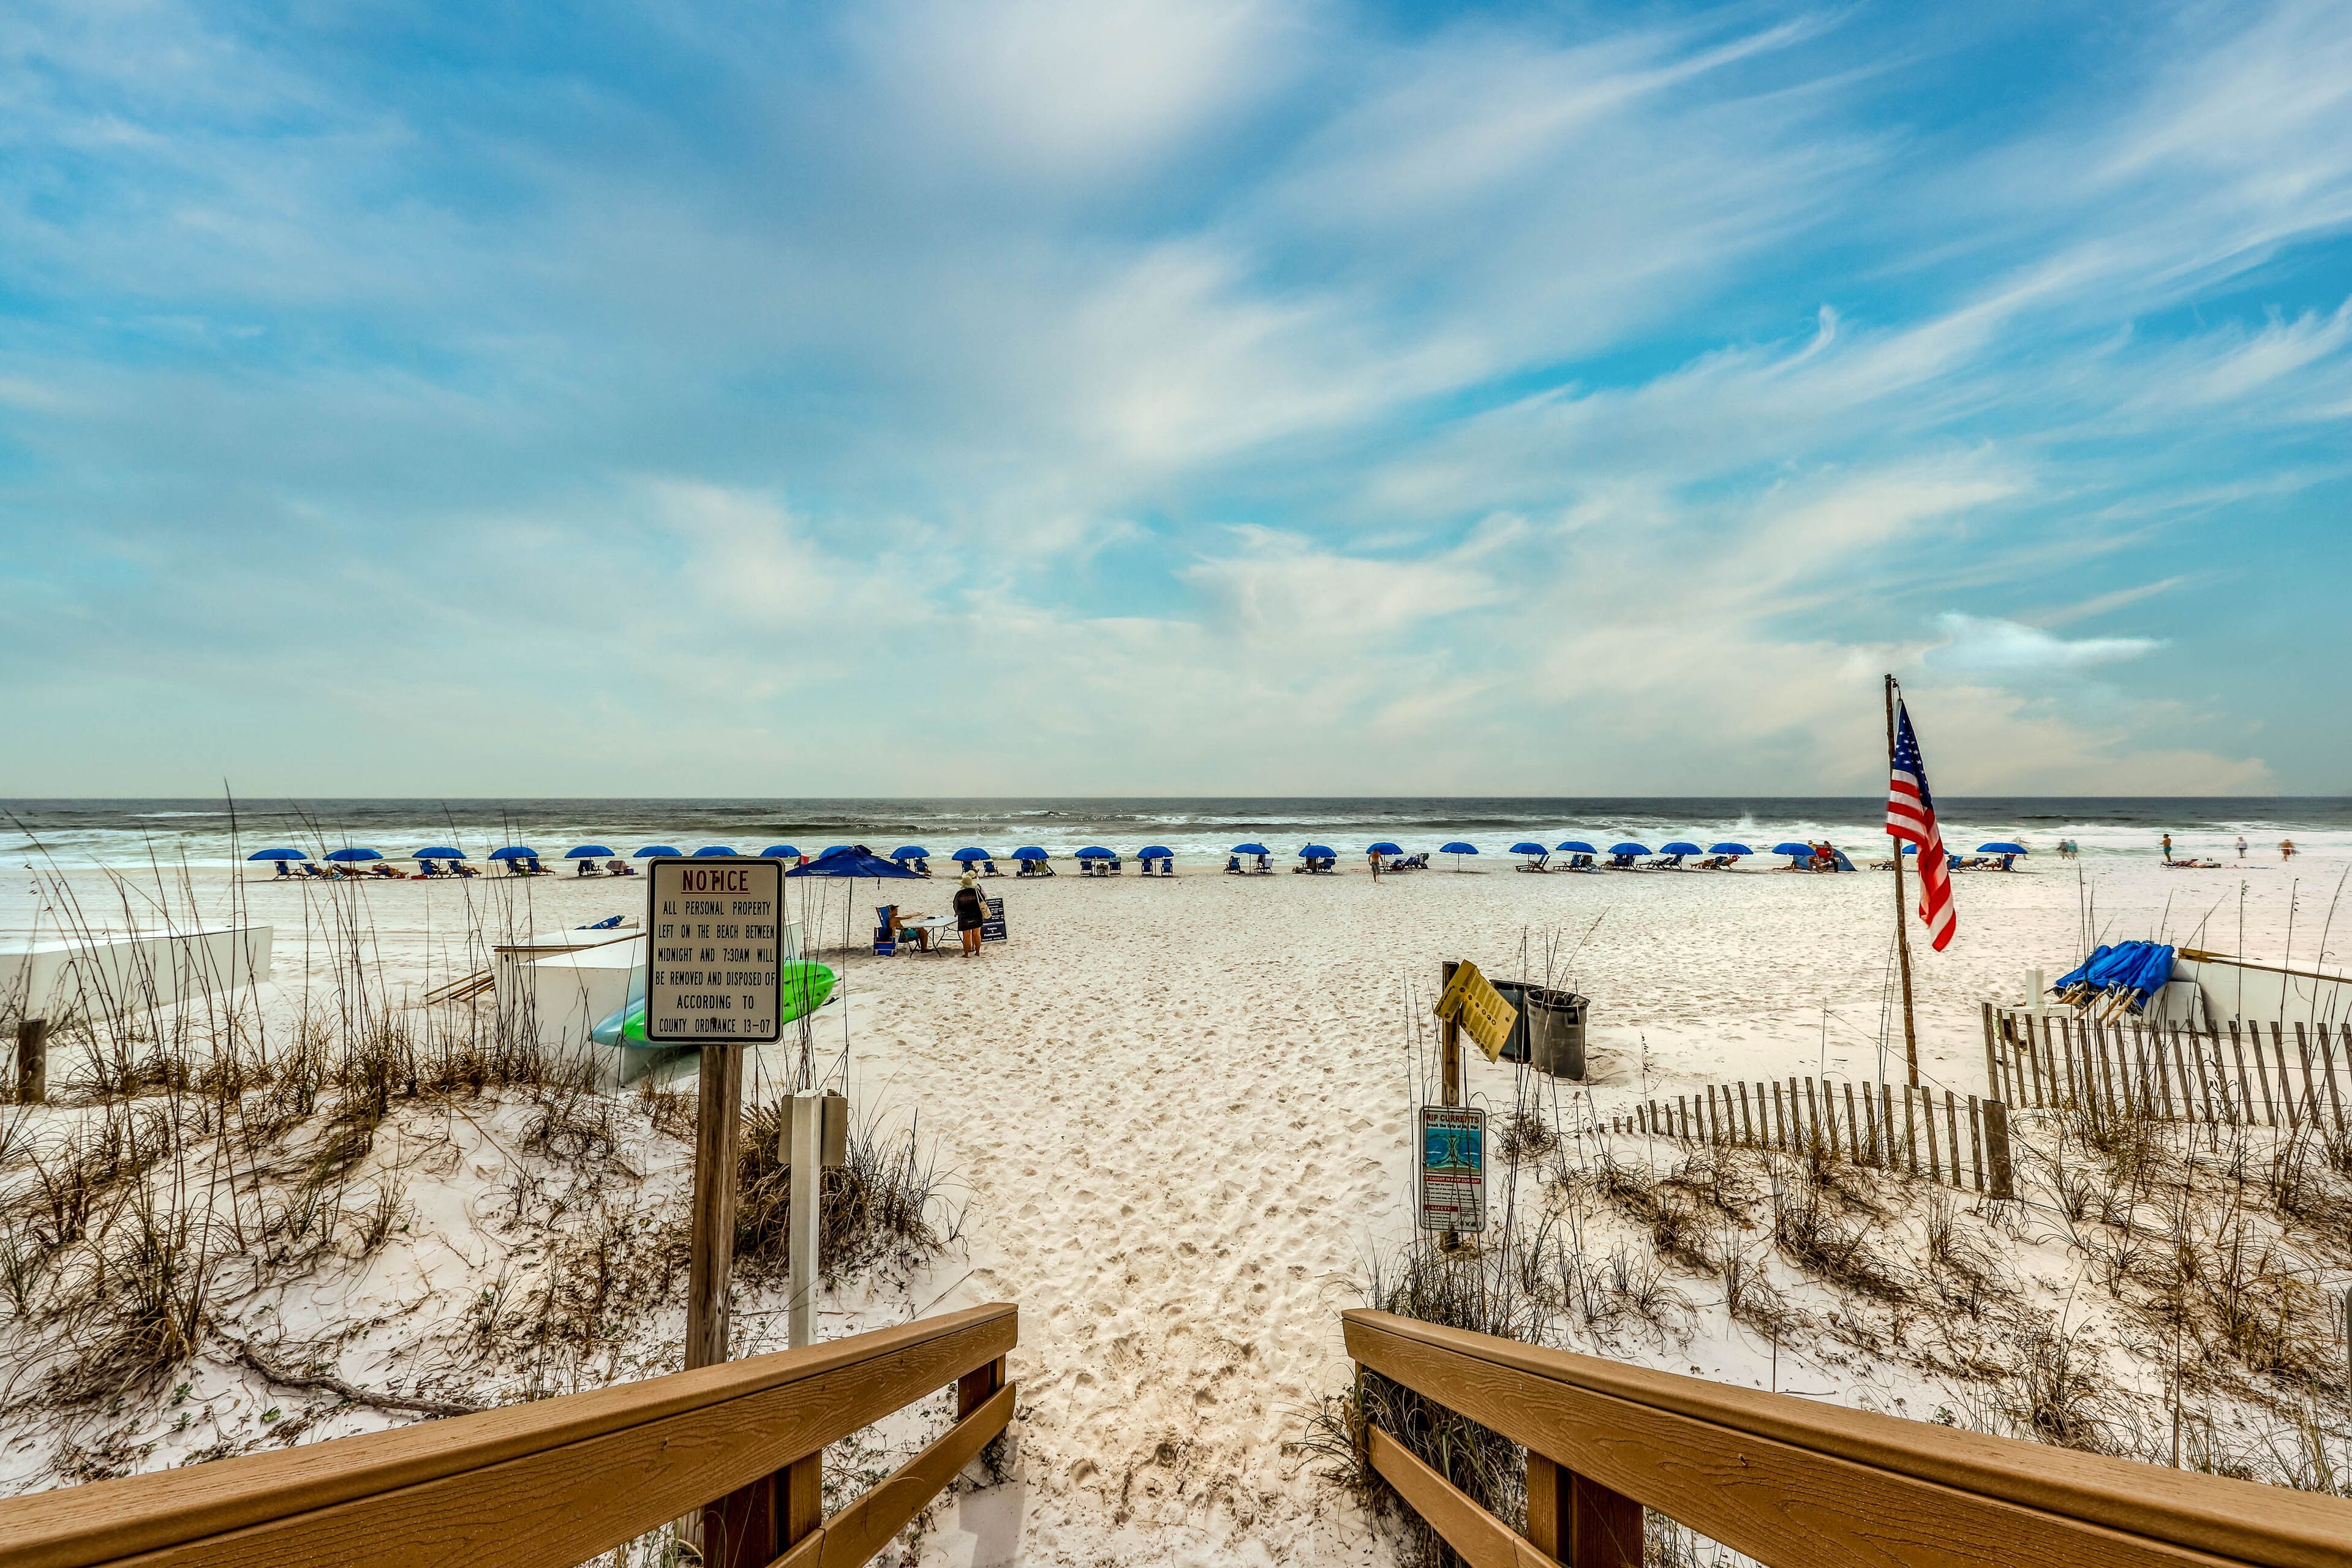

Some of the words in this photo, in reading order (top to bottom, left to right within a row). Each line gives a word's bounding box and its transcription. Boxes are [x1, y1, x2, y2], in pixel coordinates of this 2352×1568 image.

[682, 870, 748, 891] NOTICE
[663, 901, 677, 915] ALL
[685, 901, 724, 915] PERSONAL
[733, 901, 771, 915] PROPERTY
[658, 924, 674, 938] LEFT
[681, 924, 690, 938] ON
[697, 924, 709, 938] THE
[717, 924, 738, 938] BEACH
[745, 924, 774, 939] BETWEEN
[658, 948, 693, 962] MIDNIGHT
[699, 948, 715, 962] AND
[723, 948, 750, 962] 7:30AM
[757, 948, 774, 962] WILL
[655, 971, 665, 985] BE
[670, 971, 703, 986] REMOVED
[707, 971, 722, 986] AND
[726, 971, 761, 986] DISPOSED
[765, 972, 775, 986] OF
[676, 995, 731, 1009] ACCORDING
[742, 995, 754, 1009] TO
[659, 1019, 687, 1032] COUNTY
[695, 1019, 736, 1033] ORDINANCE
[744, 1019, 770, 1033] 13-07
[1440, 1114, 1479, 1123] CURRENTS
